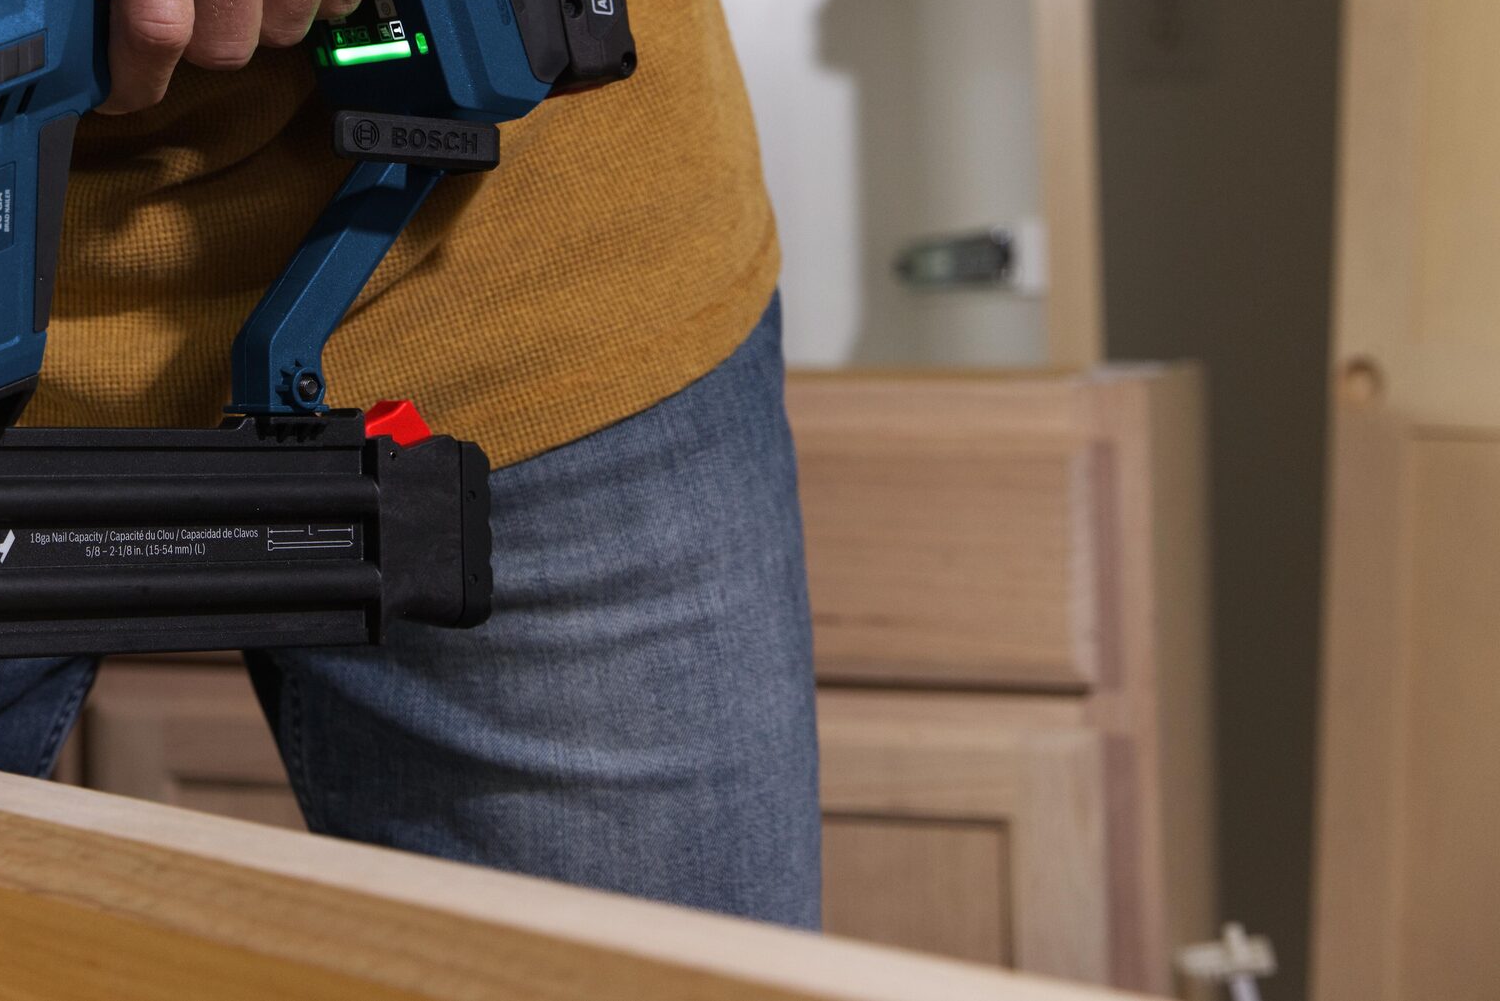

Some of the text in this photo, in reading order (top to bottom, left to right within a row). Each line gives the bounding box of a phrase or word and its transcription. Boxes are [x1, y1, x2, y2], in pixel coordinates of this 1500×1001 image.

[391, 127, 478, 154] BOSCH
[30, 533, 50, 545] 18ga
[52, 532, 67, 543] Nail
[68, 531, 103, 544] Capacity
[110, 530, 144, 543] Capacité
[145, 530, 156, 540] du
[157, 530, 175, 540] Clou
[181, 529, 222, 542] Capacidad
[223, 529, 233, 538] de
[233, 528, 259, 538] Clavos
[86, 546, 101, 558] 5/8
[109, 545, 133, 557] 2-1/8
[134, 546, 144, 556] in.
[145, 544, 173, 556] (15-54
[174, 543, 193, 555] mm)
[195, 543, 206, 556] (L)
